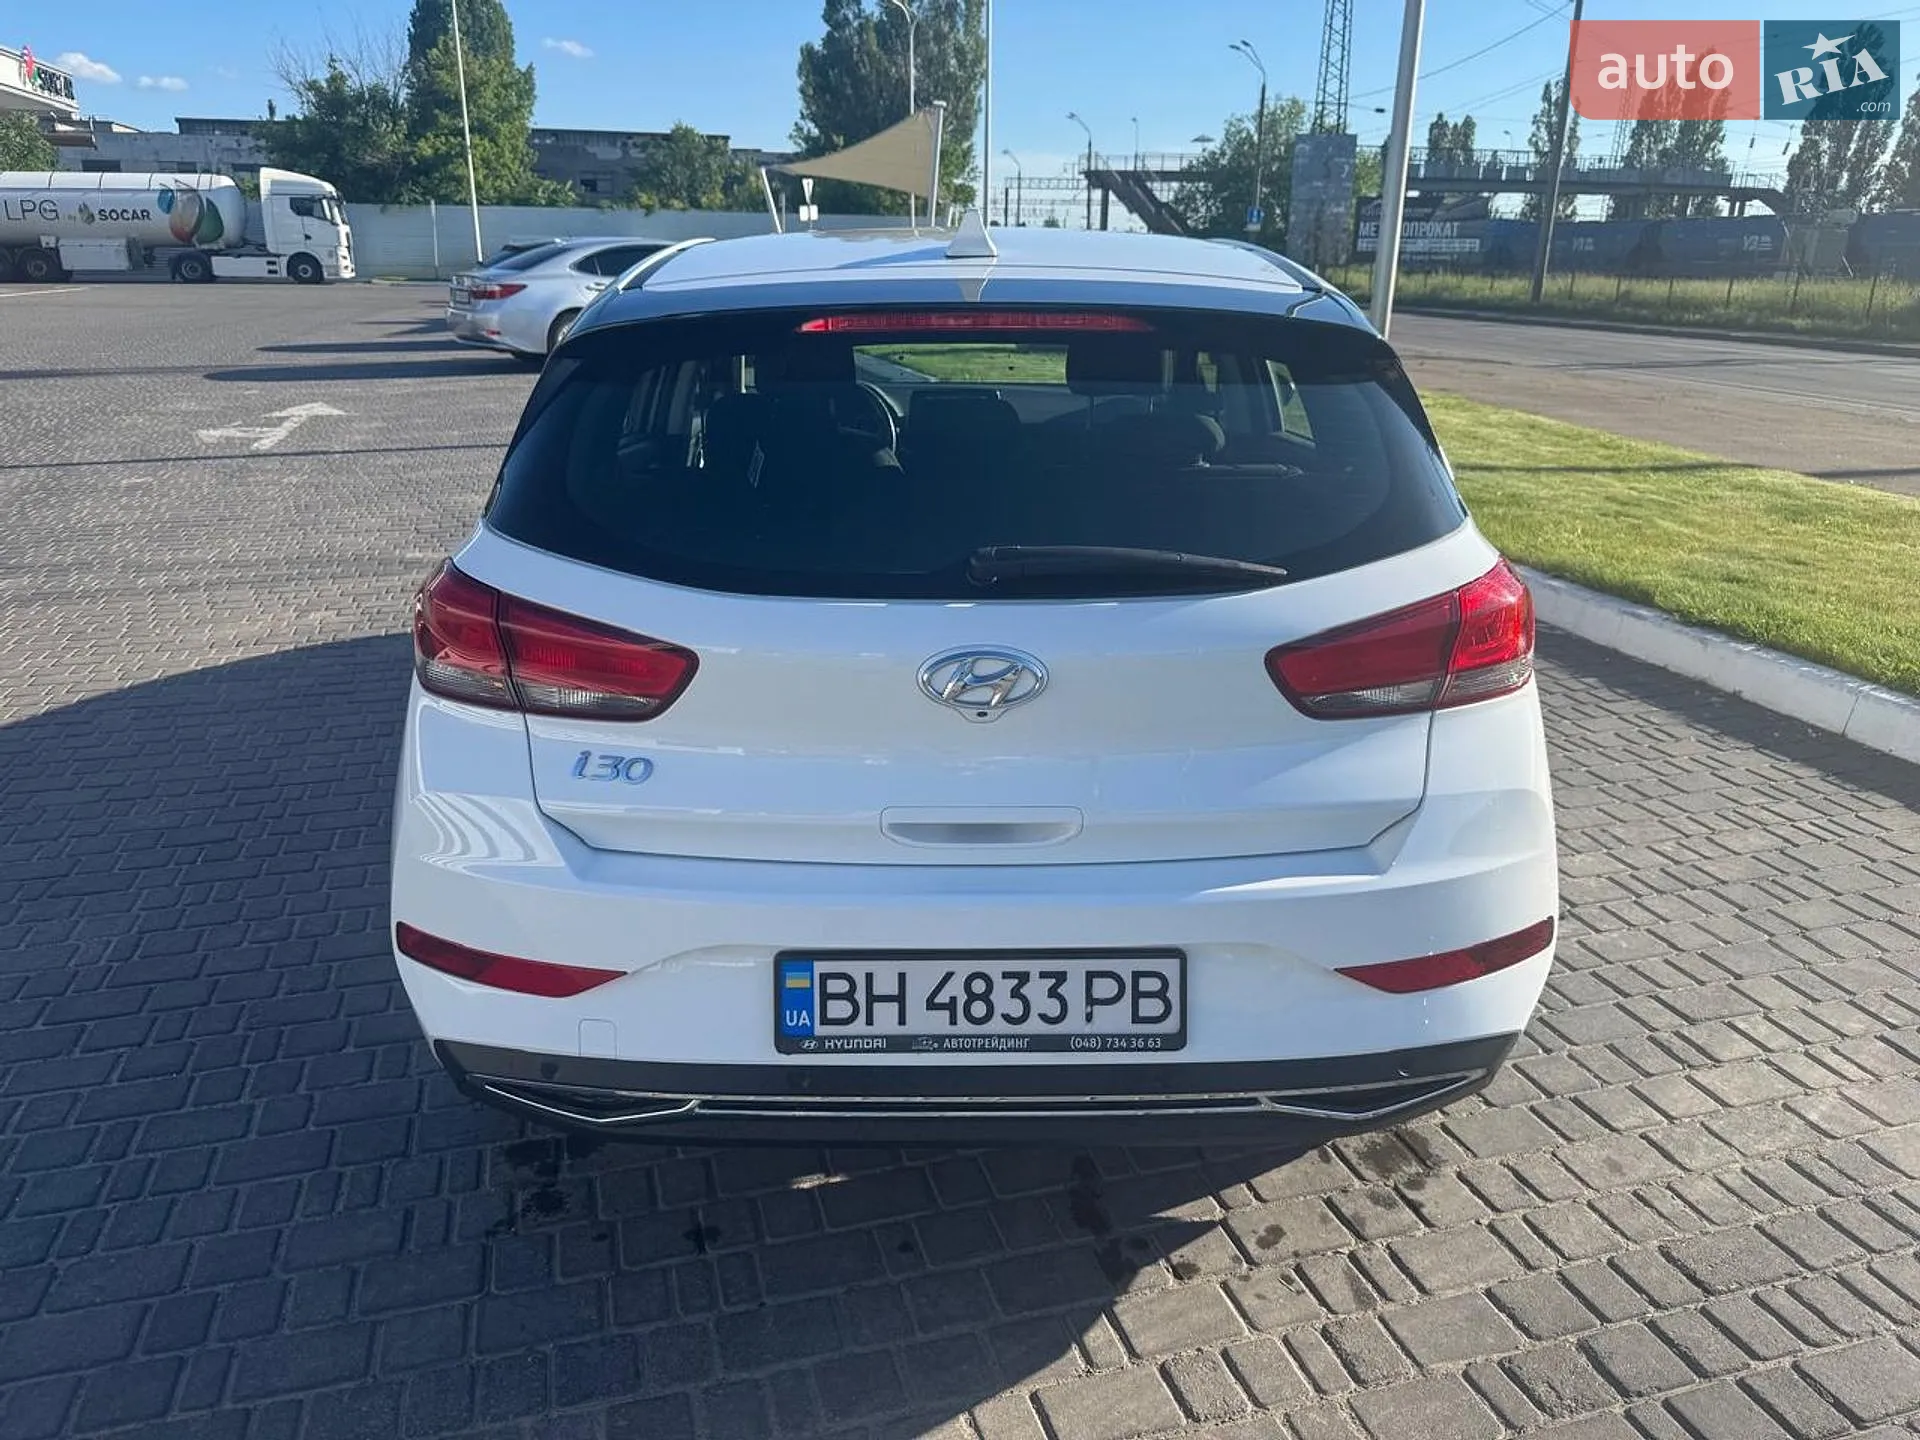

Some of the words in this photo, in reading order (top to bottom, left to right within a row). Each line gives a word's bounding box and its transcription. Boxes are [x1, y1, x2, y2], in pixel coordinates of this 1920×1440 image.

[3, 199, 60, 221] LPG
[98, 208, 151, 221] SOCAR
[1358, 222, 1460, 238] МЕОПРОКАТ
[573, 750, 654, 785] i30
[818, 971, 907, 1026] BH
[925, 971, 1069, 1026] 4833
[1085, 970, 1173, 1024] PB
[786, 1010, 811, 1026] UA
[824, 1038, 887, 1049] HYUNDAI
[942, 1036, 1030, 1050] АВТОТРЕЙДИНГ
[1070, 1036, 1101, 1049] (048)
[1106, 1038, 1127, 1048] 734
[1130, 1038, 1144, 1048] 36
[1147, 1038, 1161, 1048] 63
